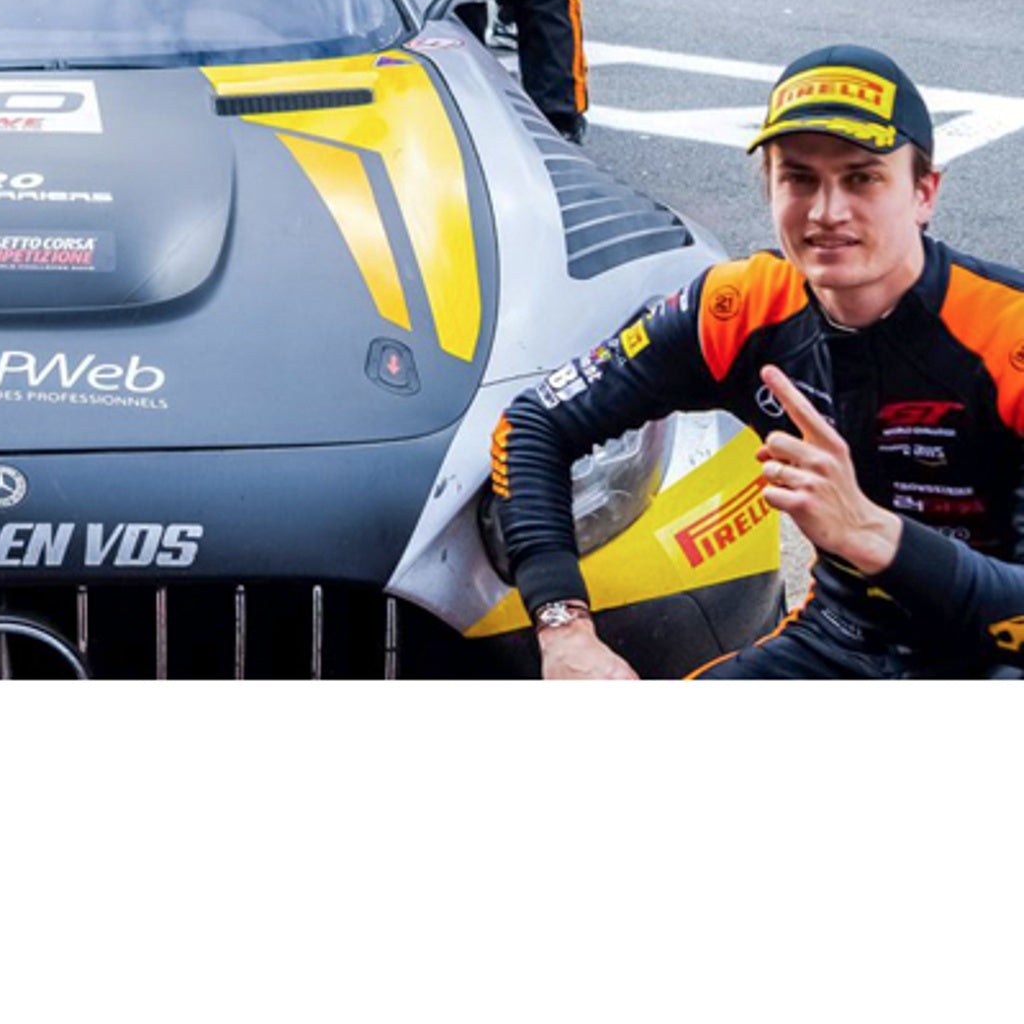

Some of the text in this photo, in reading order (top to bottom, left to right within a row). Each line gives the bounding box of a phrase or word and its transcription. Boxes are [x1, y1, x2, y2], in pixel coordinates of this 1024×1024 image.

[776, 73, 884, 110] PIRELLI
[42, 236, 95, 251] CORSA
[27, 391, 168, 410] PROFESSIONNELS
[674, 474, 769, 568] PIRELL
[83, 523, 204, 568] VDS
